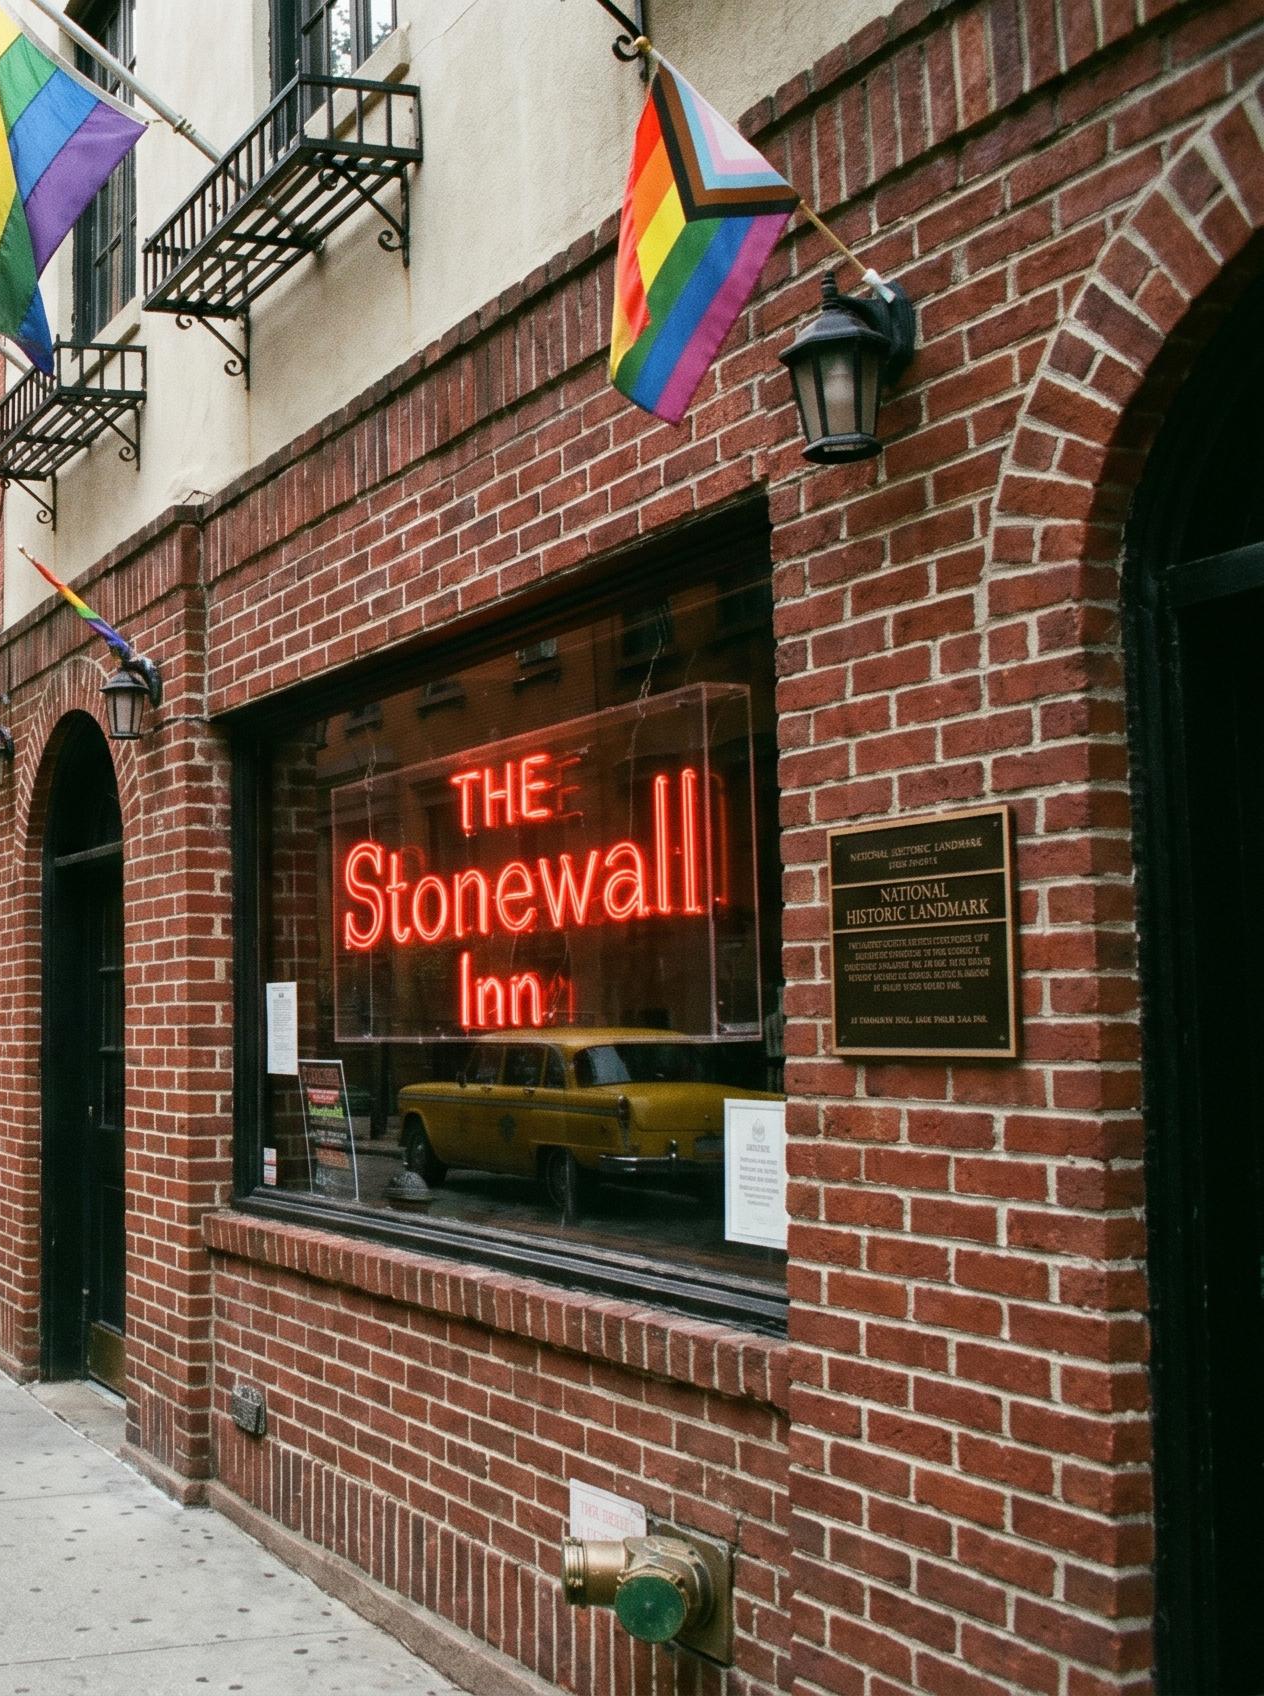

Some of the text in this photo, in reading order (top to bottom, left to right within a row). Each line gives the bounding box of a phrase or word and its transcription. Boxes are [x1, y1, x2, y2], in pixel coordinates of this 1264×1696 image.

[450, 754, 550, 833] THE
[345, 768, 703, 949] Stonewall
[880, 882, 949, 902] NATIONAL
[846, 898, 989, 925] HISTORIC LANDMARK
[460, 951, 545, 1027] Inn
